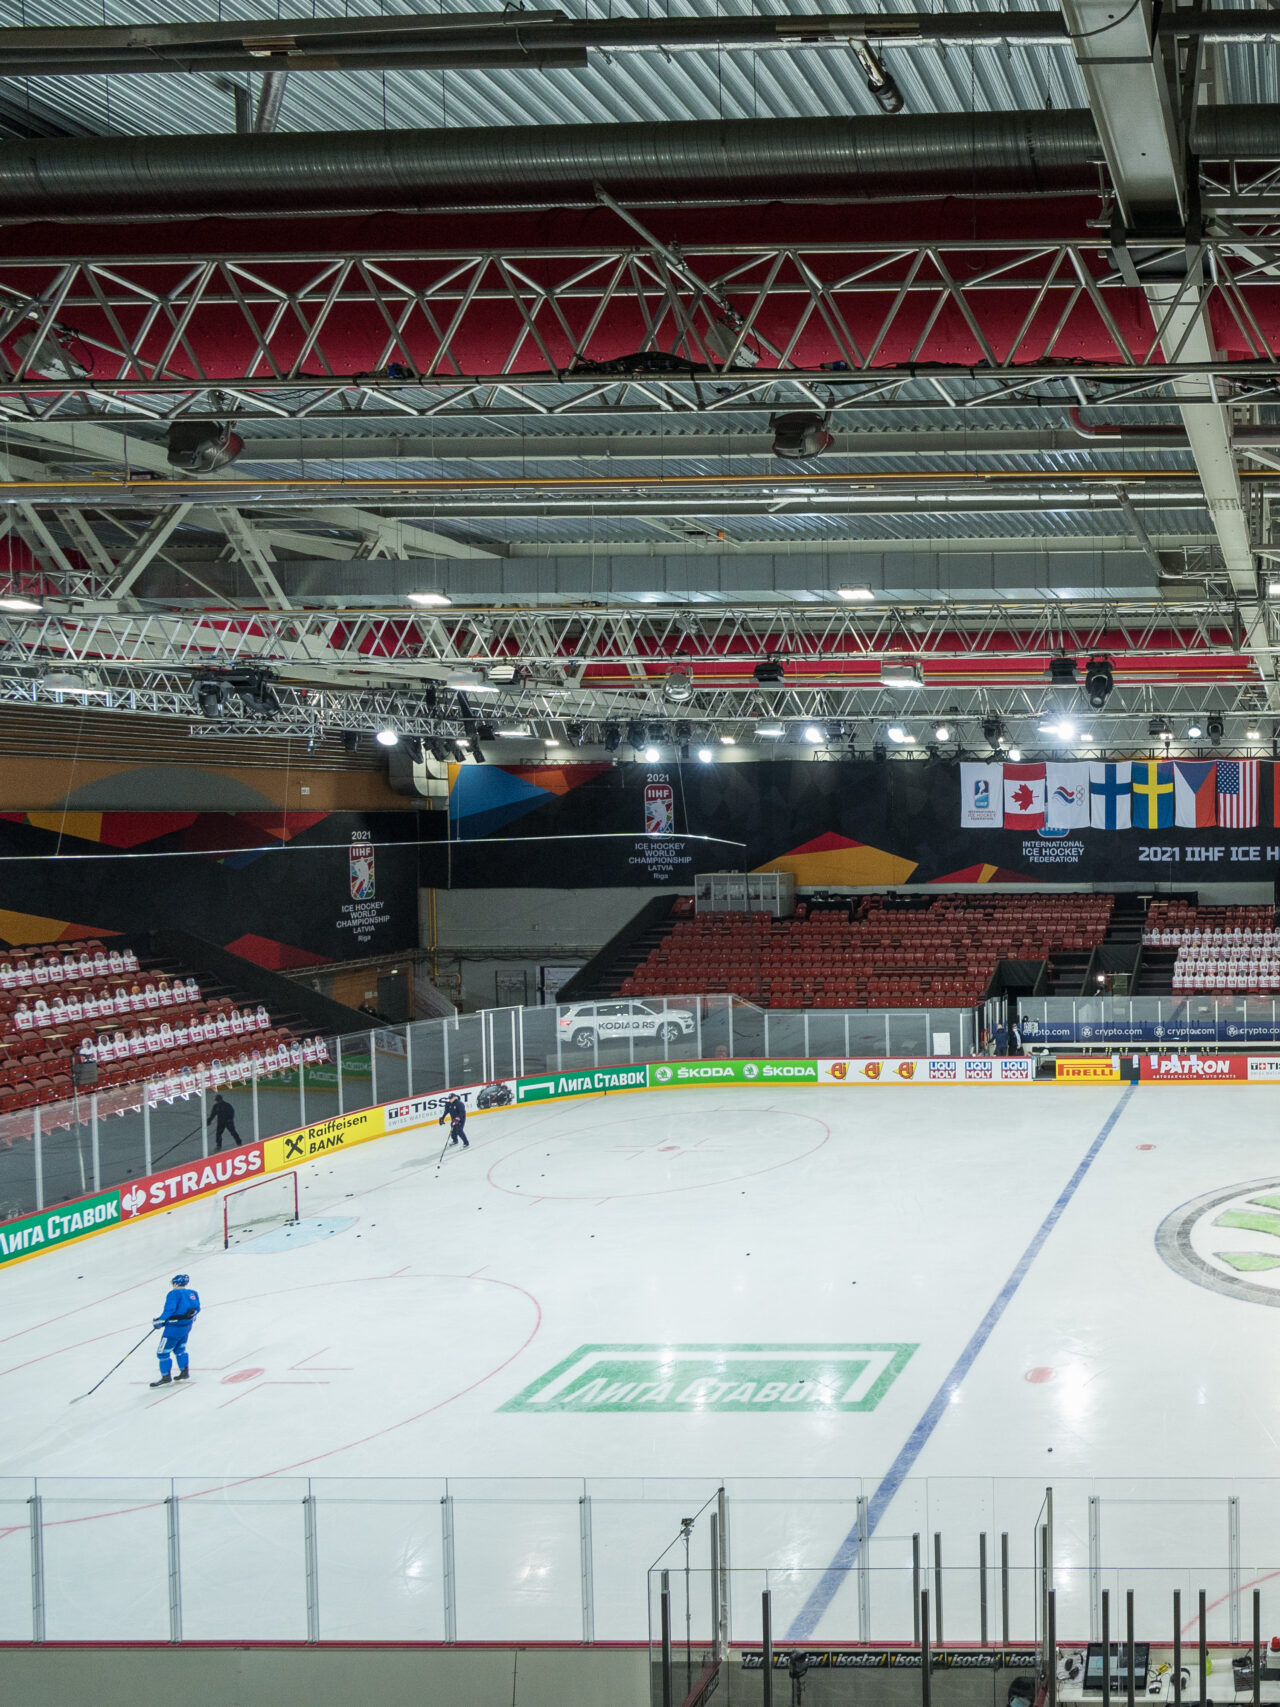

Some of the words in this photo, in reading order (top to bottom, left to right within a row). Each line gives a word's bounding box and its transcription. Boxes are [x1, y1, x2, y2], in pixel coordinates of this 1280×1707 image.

[646, 774, 670, 782] 2021
[648, 789, 670, 798] IIHF
[351, 830, 372, 840] 2021
[650, 842, 686, 850] HOCKEY
[1022, 840, 1084, 848] INTERNATIONAL
[352, 847, 371, 857] IIHF
[1022, 848, 1040, 856] ICE
[1042, 848, 1085, 856] HOCKEY
[1138, 846, 1180, 862] 2021
[1185, 846, 1226, 862] IIHF
[1230, 846, 1261, 862] ICE
[628, 856, 692, 864] CHAMPIONSHIP
[342, 904, 354, 912] ICE
[355, 902, 384, 911] HOCKEY
[350, 910, 377, 919] WORLD
[336, 914, 390, 929] CHAMPIONSHIP
[353, 924, 376, 934] LATVIA
[598, 1022, 640, 1030] KODIAQ
[642, 1021, 656, 1029] RS
[1094, 1028, 1142, 1037] crypto.com
[1167, 1027, 1215, 1036] crypto.com
[762, 1064, 816, 1077] ŠKODA
[930, 1062, 956, 1070] LIQUI
[966, 1062, 992, 1070] LIQUI
[1002, 1062, 1028, 1070] LIQUI
[1058, 1064, 1114, 1076] PIRELLI
[1160, 1060, 1230, 1074] PATRON
[678, 1066, 734, 1078] ŠKODA
[930, 1070, 956, 1079] MOLY
[966, 1070, 992, 1079] MOLY
[1002, 1070, 1028, 1079] MOLY
[308, 1113, 368, 1140] Raiffeisen
[309, 1132, 344, 1154] BANK
[150, 1150, 262, 1204] STRAUSS
[835, 1653, 882, 1667] isostar
